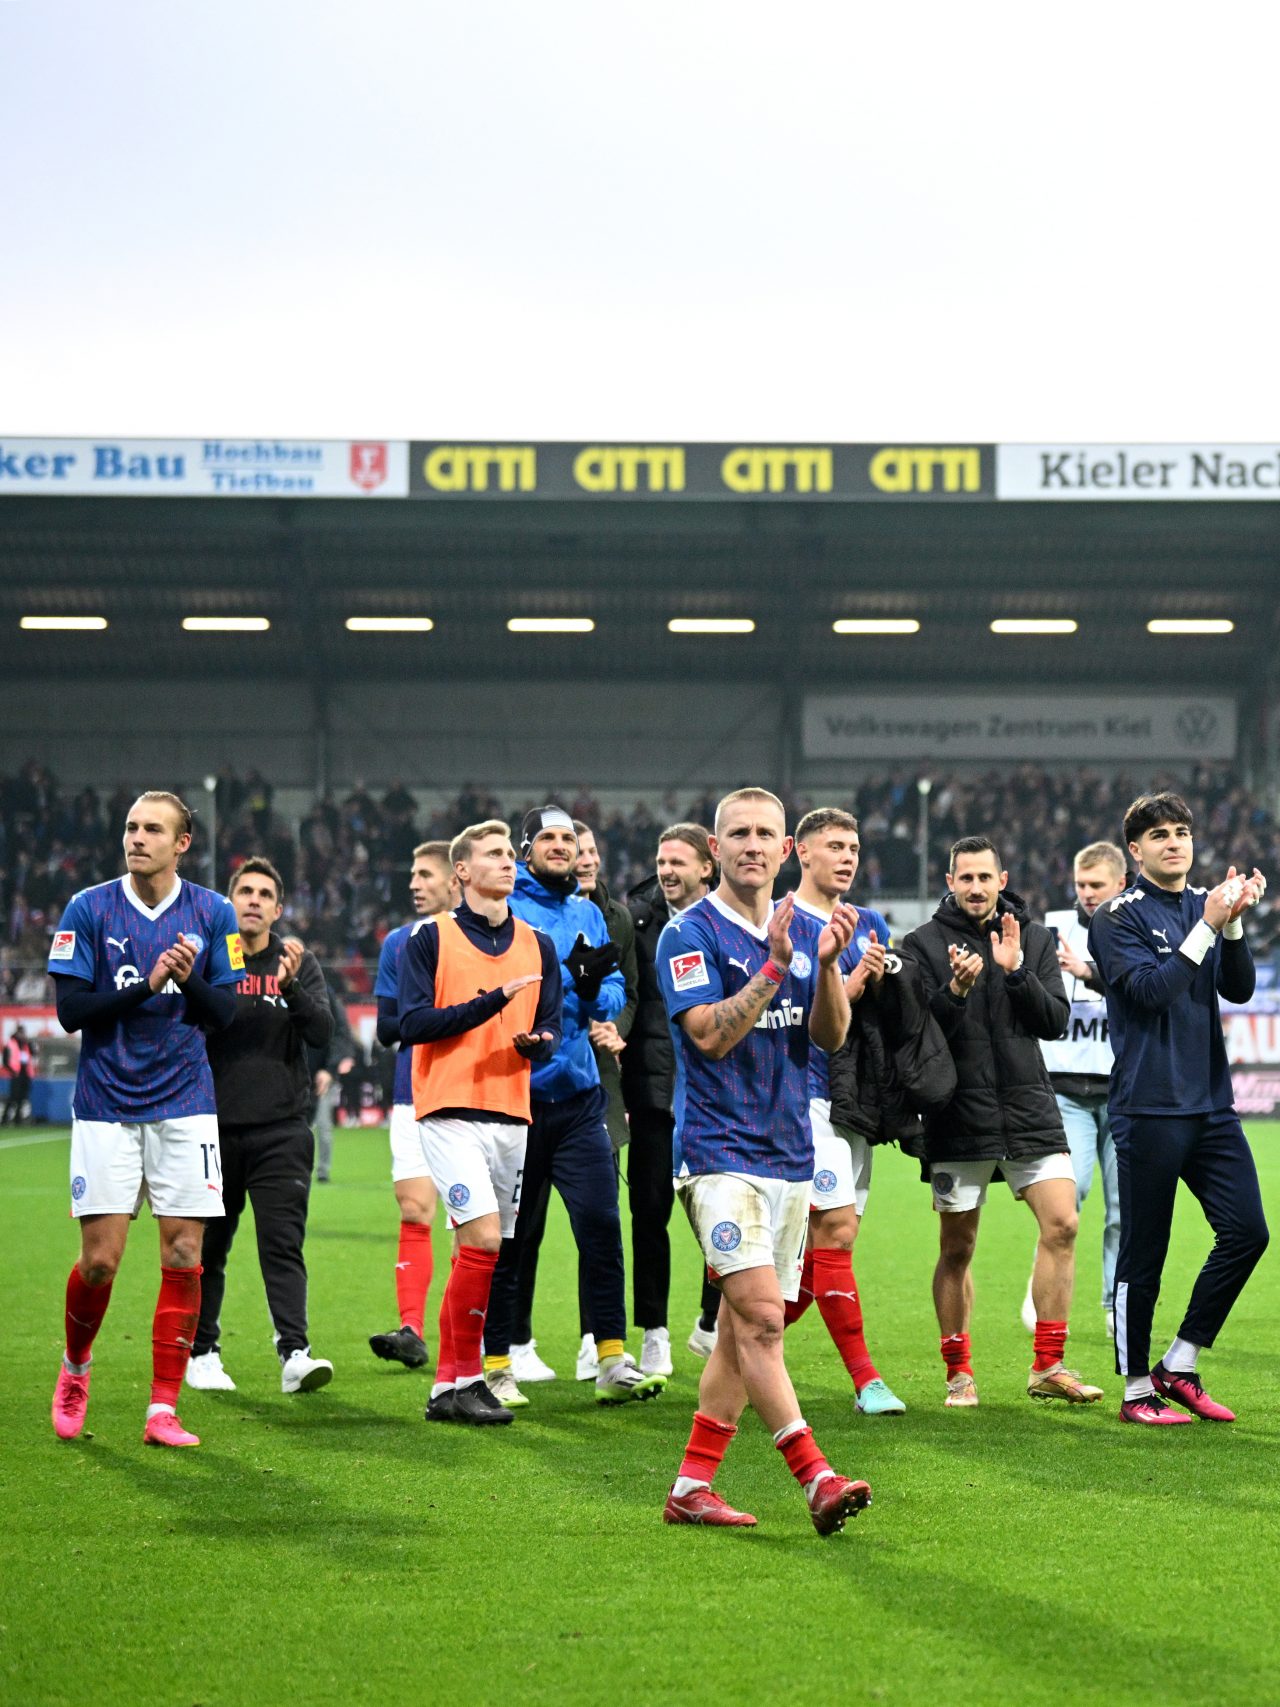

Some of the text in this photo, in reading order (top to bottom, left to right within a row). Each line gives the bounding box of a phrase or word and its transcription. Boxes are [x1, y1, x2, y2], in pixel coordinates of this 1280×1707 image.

[93, 446, 185, 479] Bau
[203, 442, 323, 463] Hochbau
[211, 471, 315, 492] Tiefbau
[1039, 452, 1177, 489] Kieler
[825, 714, 1151, 743] Volkswagen Zentrum Kiel
